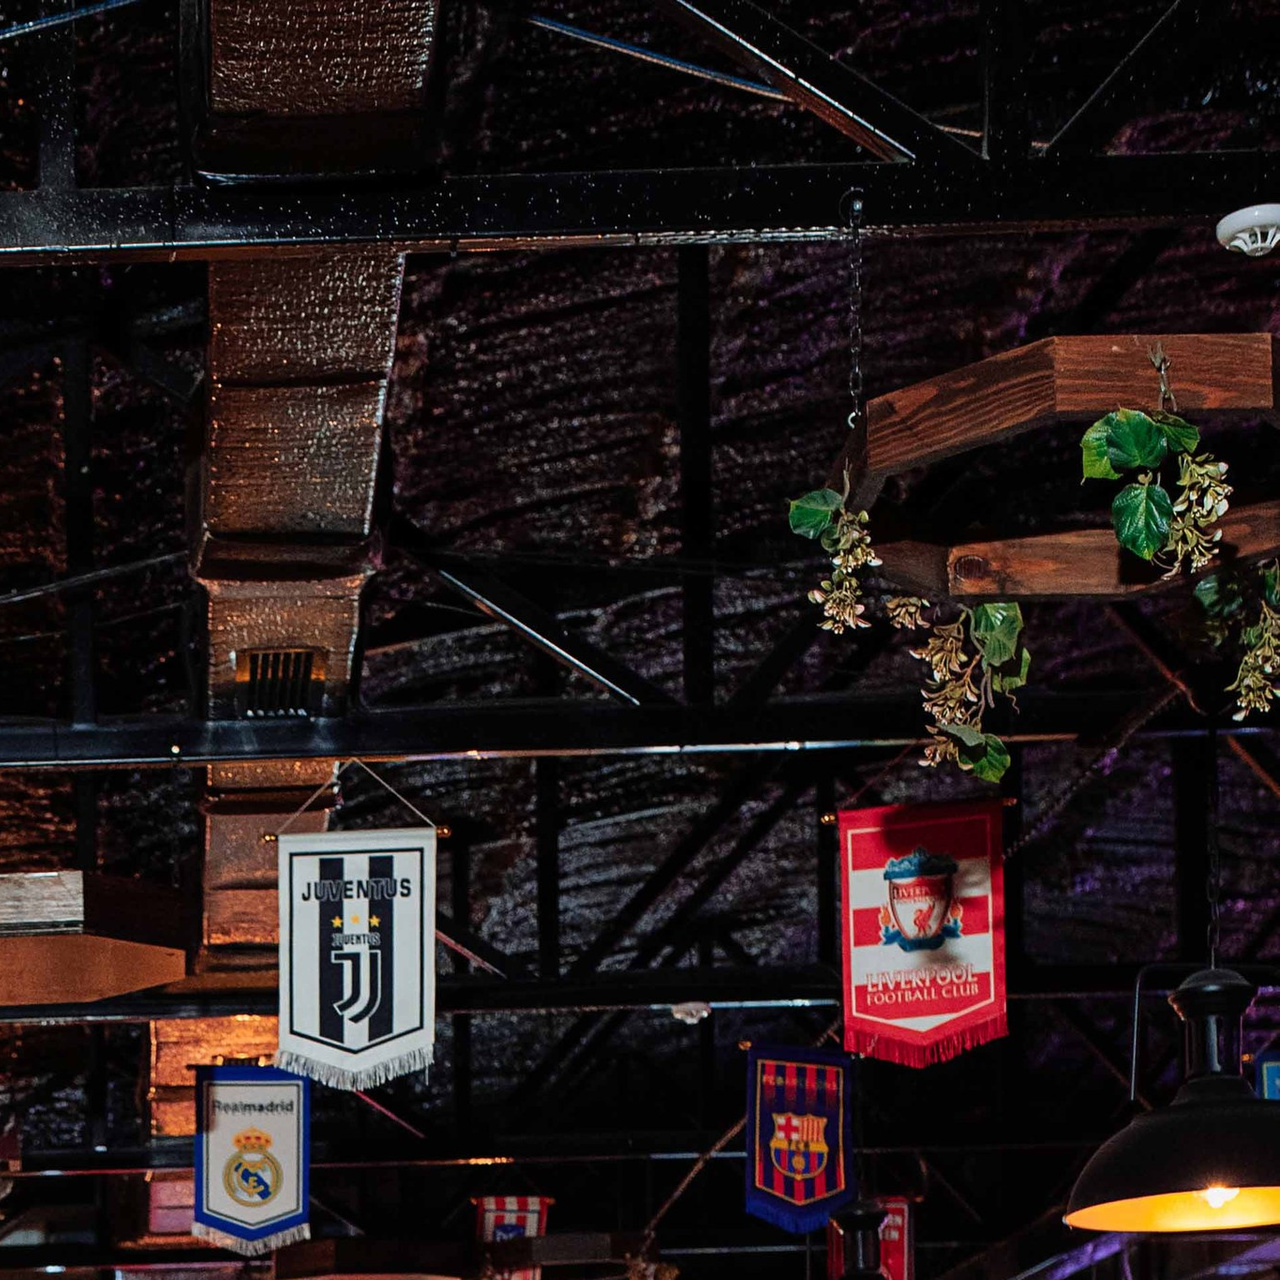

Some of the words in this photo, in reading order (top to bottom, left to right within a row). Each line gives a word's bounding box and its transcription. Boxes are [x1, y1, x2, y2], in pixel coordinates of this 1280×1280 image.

[301, 878, 412, 901] JUVENTUS
[331, 932, 382, 947] JUVENTUS
[866, 964, 978, 992] LIVERPOOL
[867, 986, 937, 1006] FOOTBALL
[941, 983, 979, 998] CLUB
